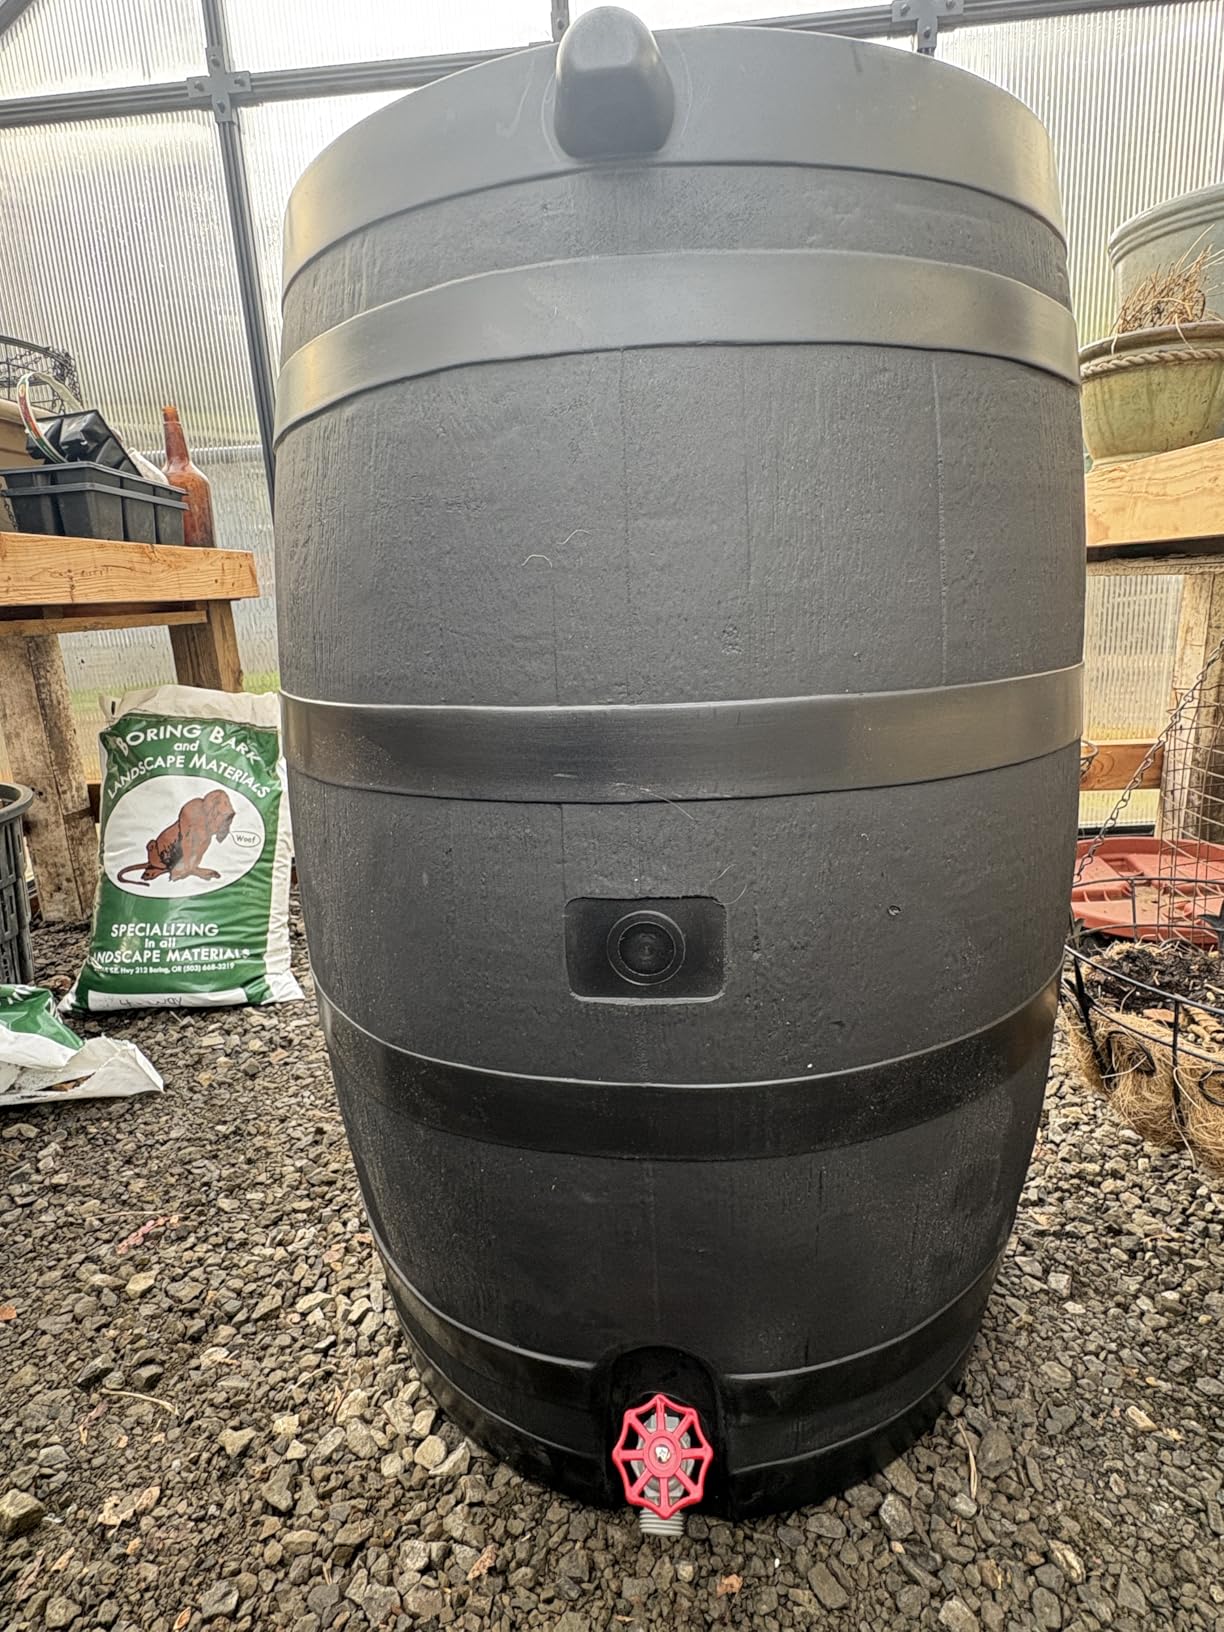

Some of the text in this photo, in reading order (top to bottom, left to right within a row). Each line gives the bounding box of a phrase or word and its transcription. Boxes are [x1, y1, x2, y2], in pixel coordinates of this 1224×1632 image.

[116, 724, 201, 757] BORING
[173, 740, 200, 752] and
[107, 753, 271, 800] LANDSCAPE MATERIALS
[111, 923, 219, 937] SPECIALIZING
[159, 937, 176, 948] all
[166, 948, 250, 962] MATERIALS
[171, 965, 182, 973] OR
